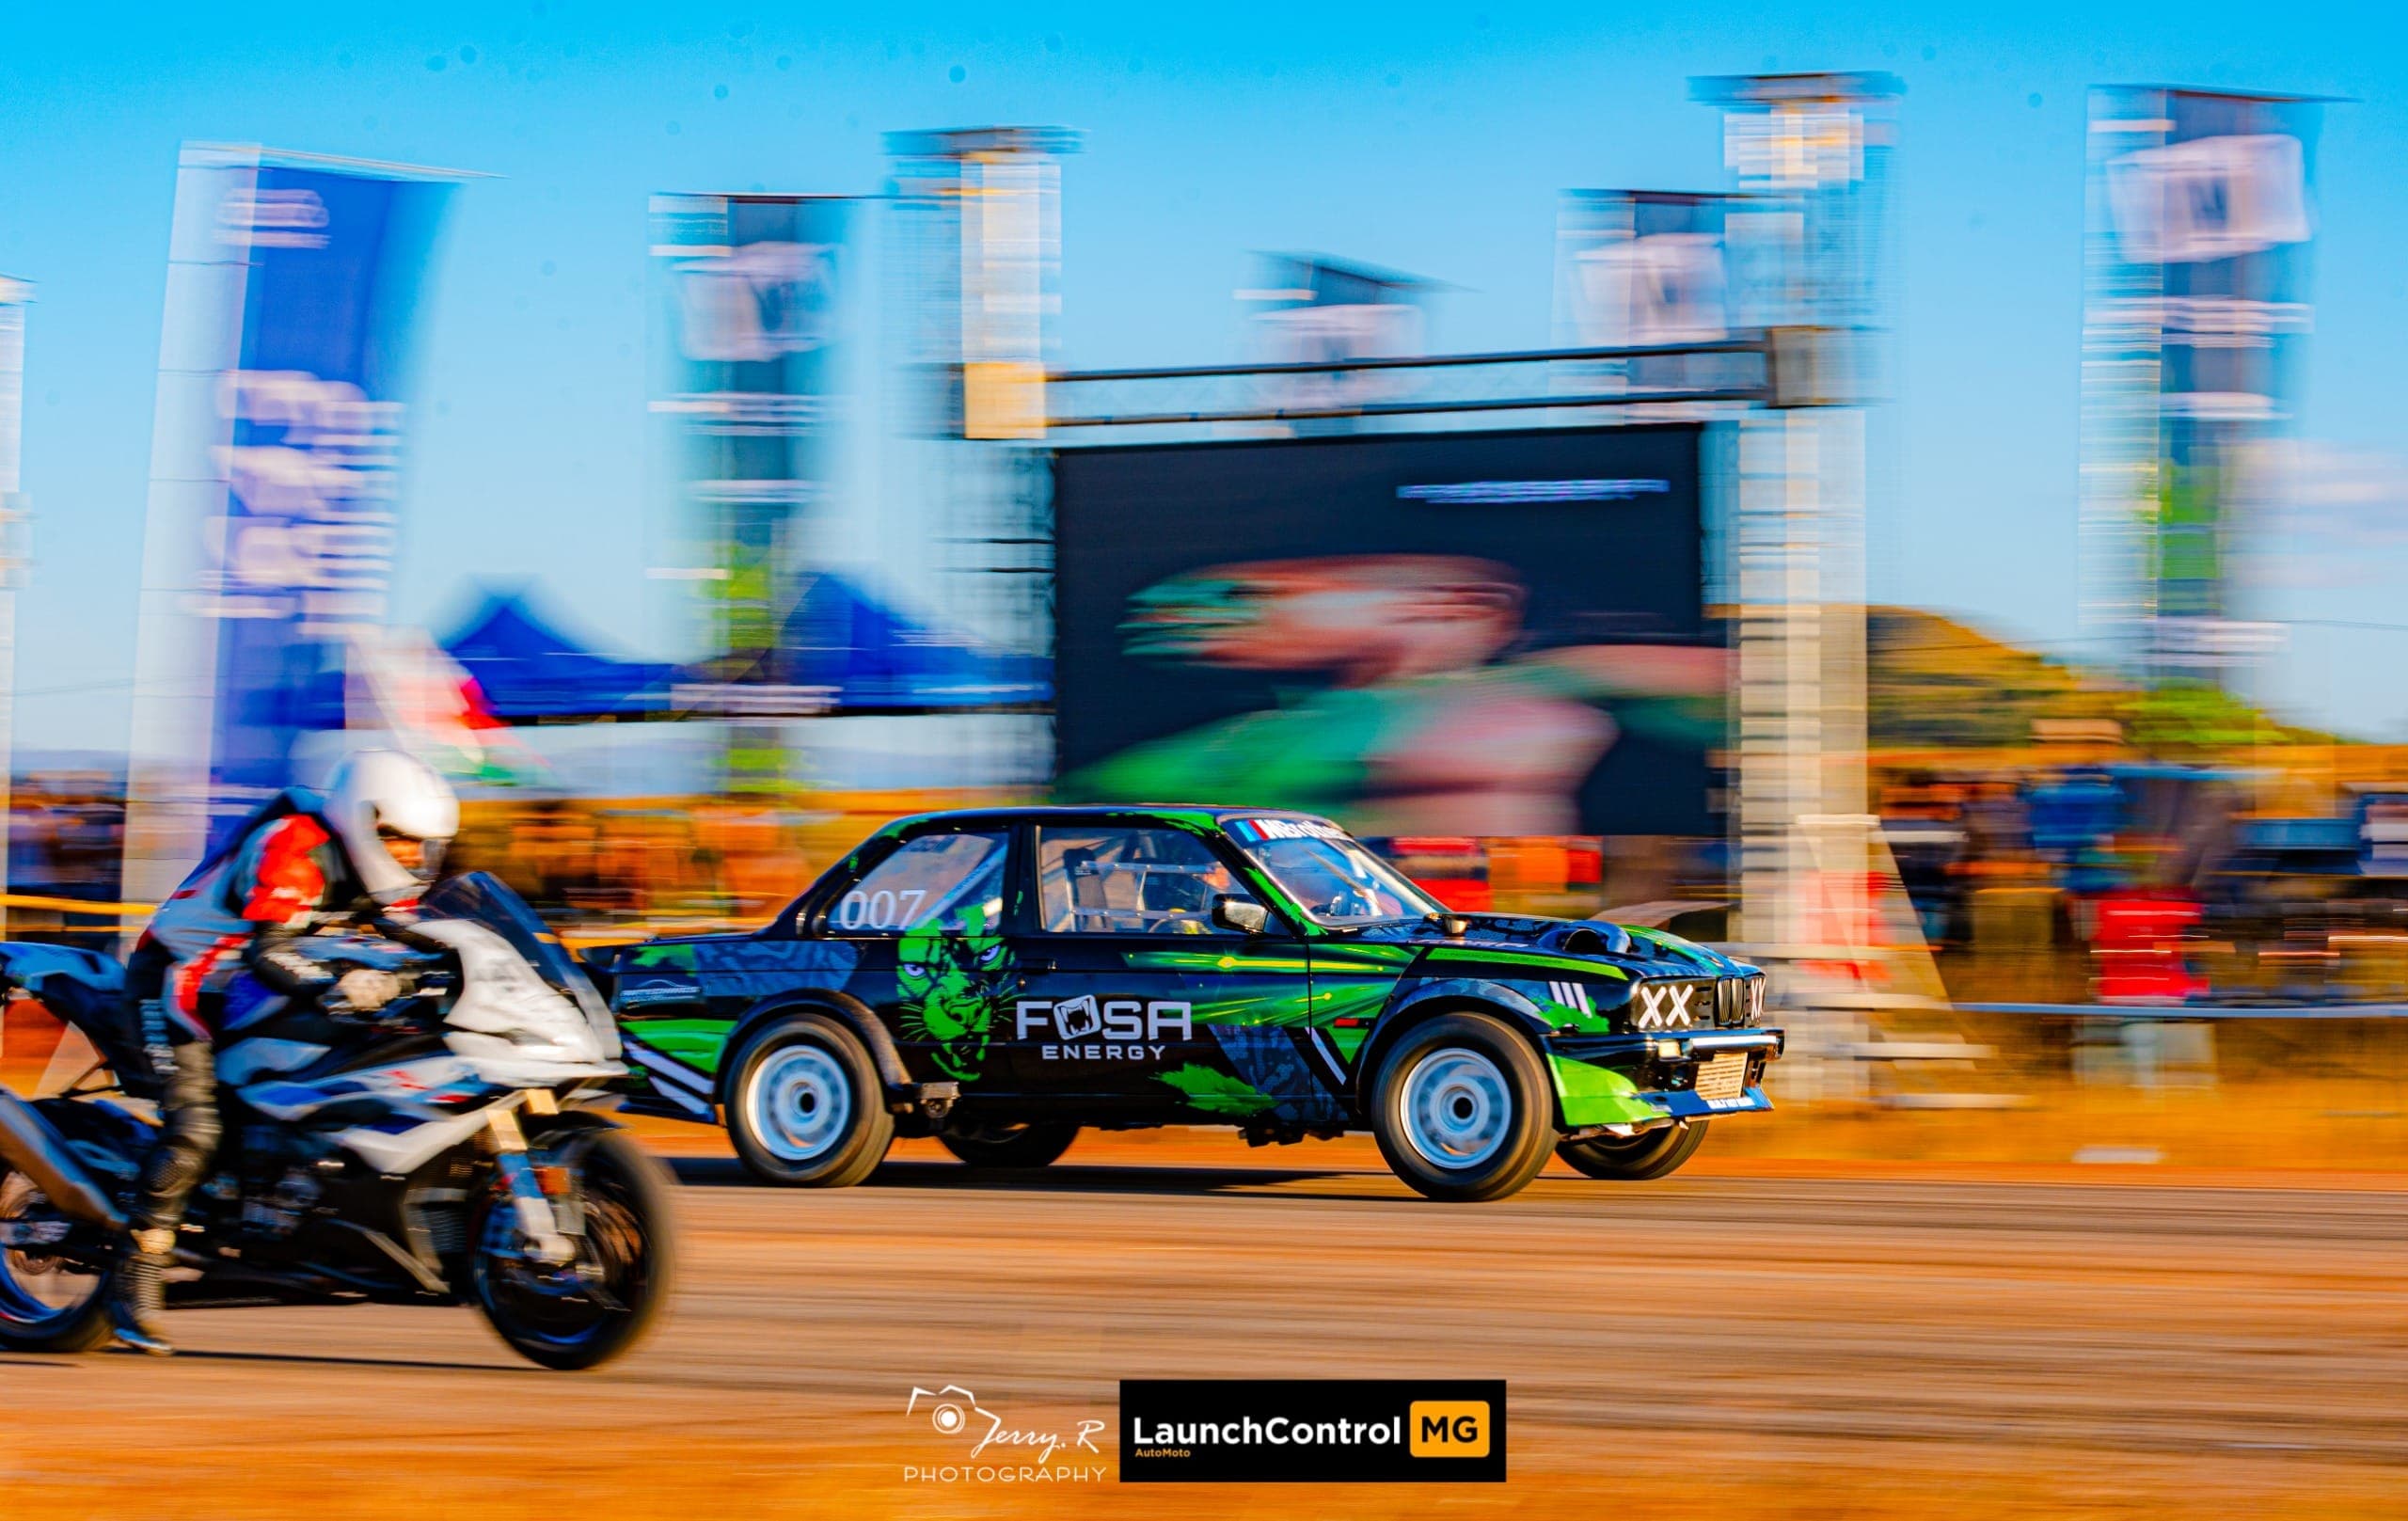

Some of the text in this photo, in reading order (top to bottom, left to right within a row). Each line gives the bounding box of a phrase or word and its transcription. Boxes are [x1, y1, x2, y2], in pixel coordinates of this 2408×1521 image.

[840, 890, 927, 930] 007
[1017, 994, 1192, 1040] FOSA
[1041, 1045, 1165, 1060] ENERGY
